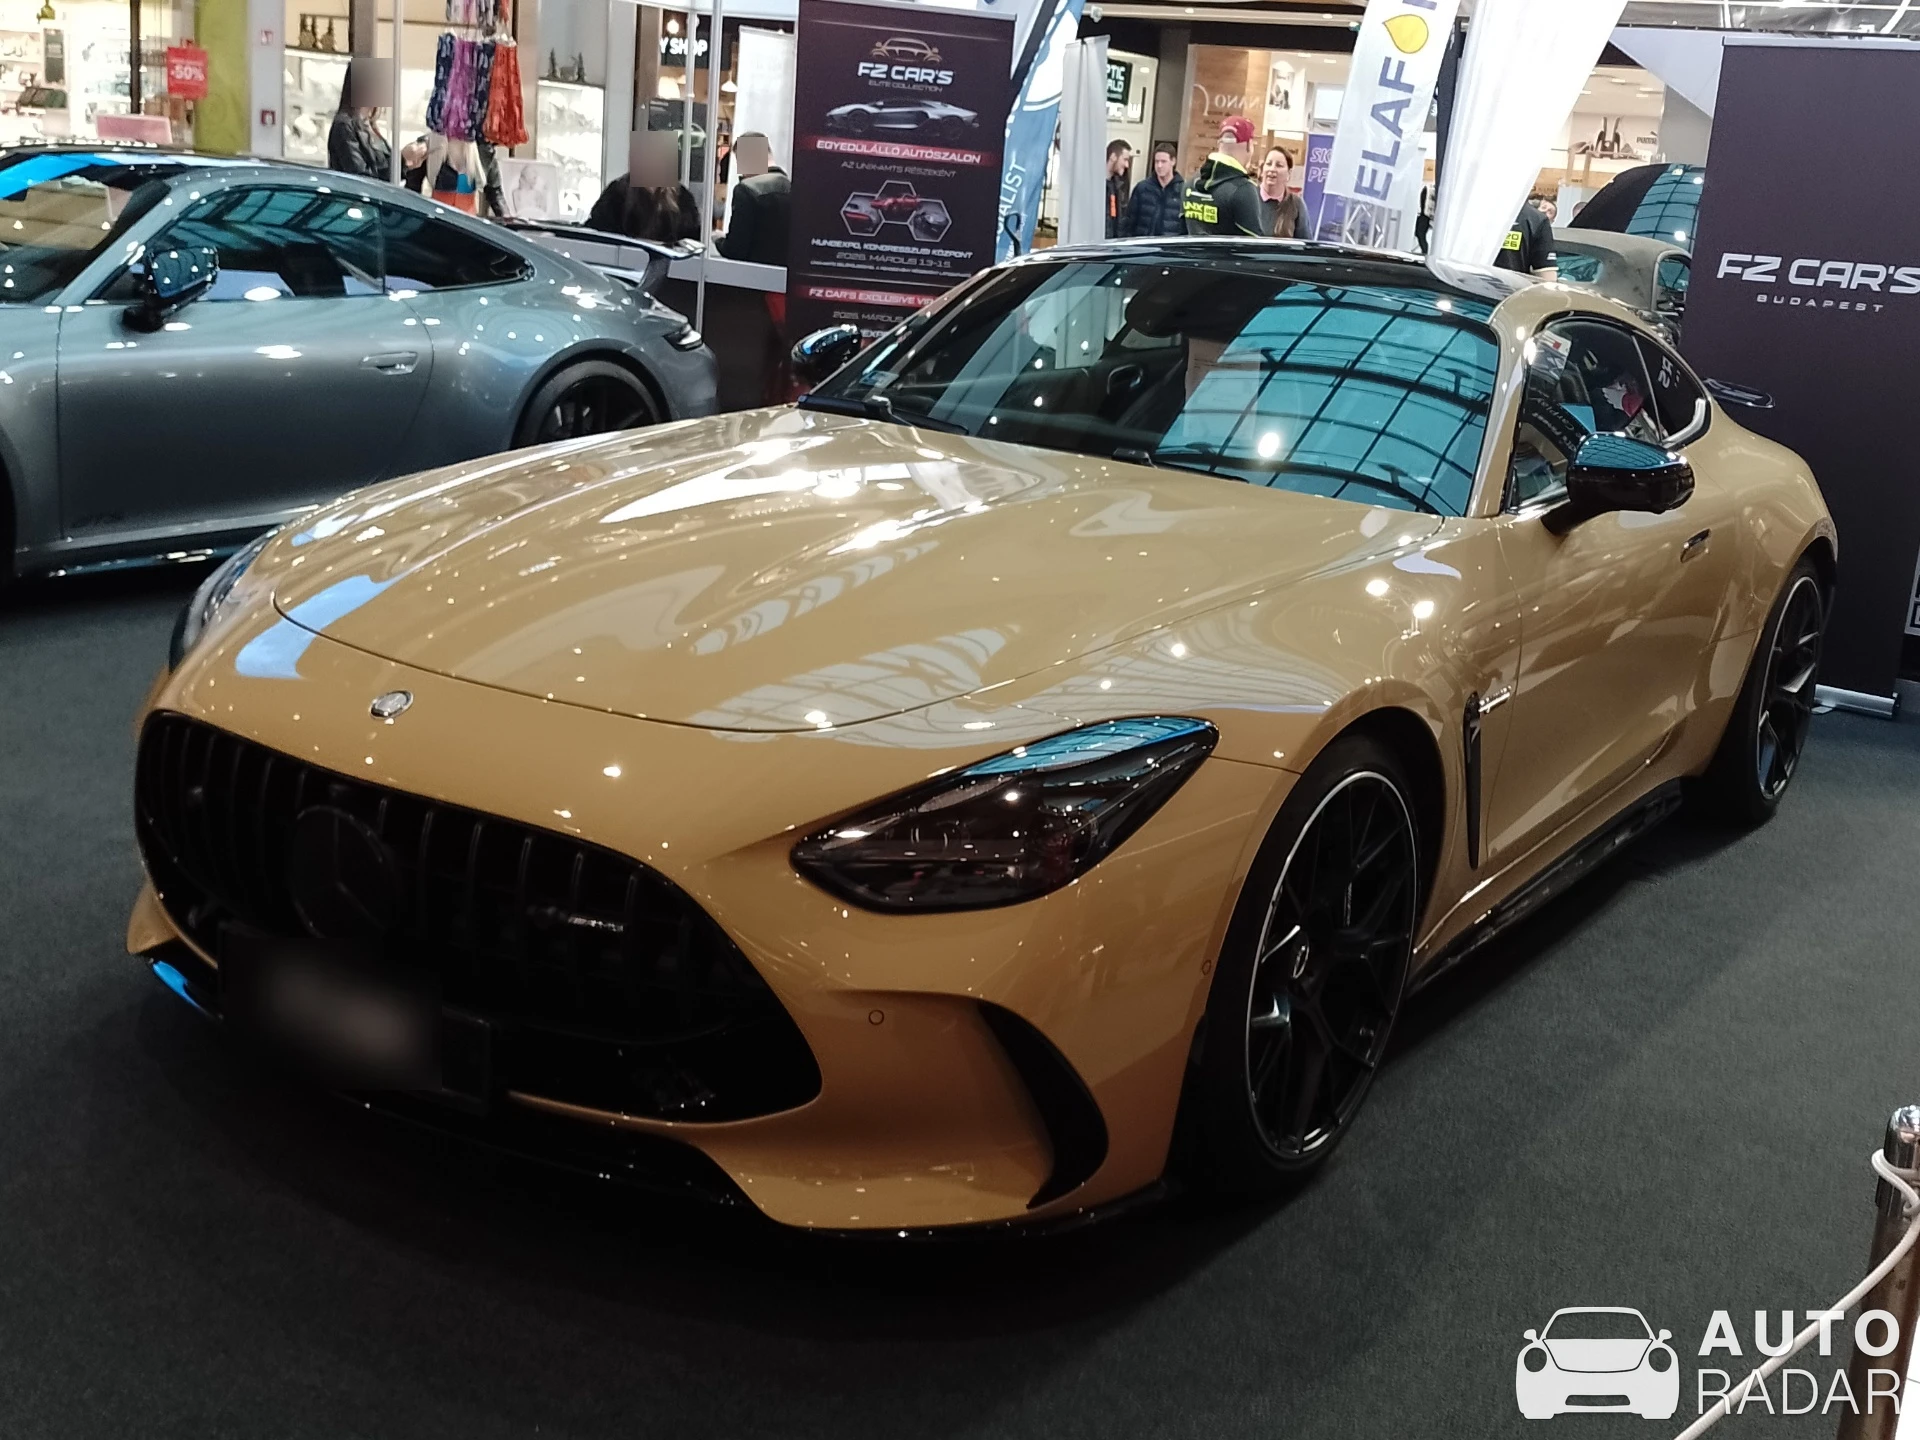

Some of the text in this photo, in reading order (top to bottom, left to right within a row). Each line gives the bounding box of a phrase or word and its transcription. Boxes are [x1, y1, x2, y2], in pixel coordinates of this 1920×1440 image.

[669, 37, 708, 56] SHP
[857, 62, 954, 85] FZ CAR'S
[841, 160, 854, 169] AZ
[901, 148, 982, 164] AUTÓSZALON
[1717, 253, 1920, 294] FZ CAR'S
[809, 287, 824, 297] FZ
[858, 292, 915, 305] EXCLUSIVE
[1756, 294, 1884, 313] BUDAPEST
